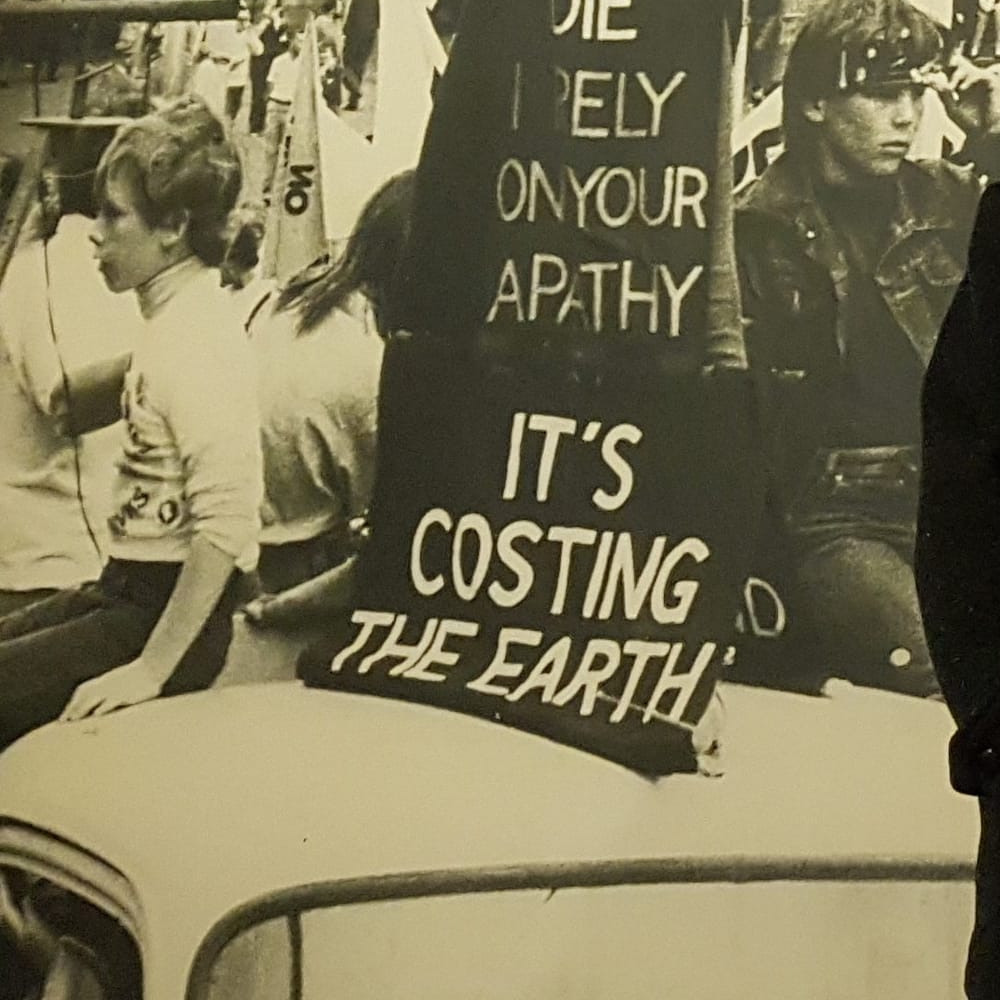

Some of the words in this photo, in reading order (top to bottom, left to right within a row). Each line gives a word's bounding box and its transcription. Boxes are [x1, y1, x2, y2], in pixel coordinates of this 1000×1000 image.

[497, 157, 566, 223] ON
[567, 165, 708, 229] YOUR
[486, 253, 703, 337] APATHY
[503, 412, 643, 511] IT'S
[411, 508, 710, 625] COSTING
[331, 610, 480, 682] THE
